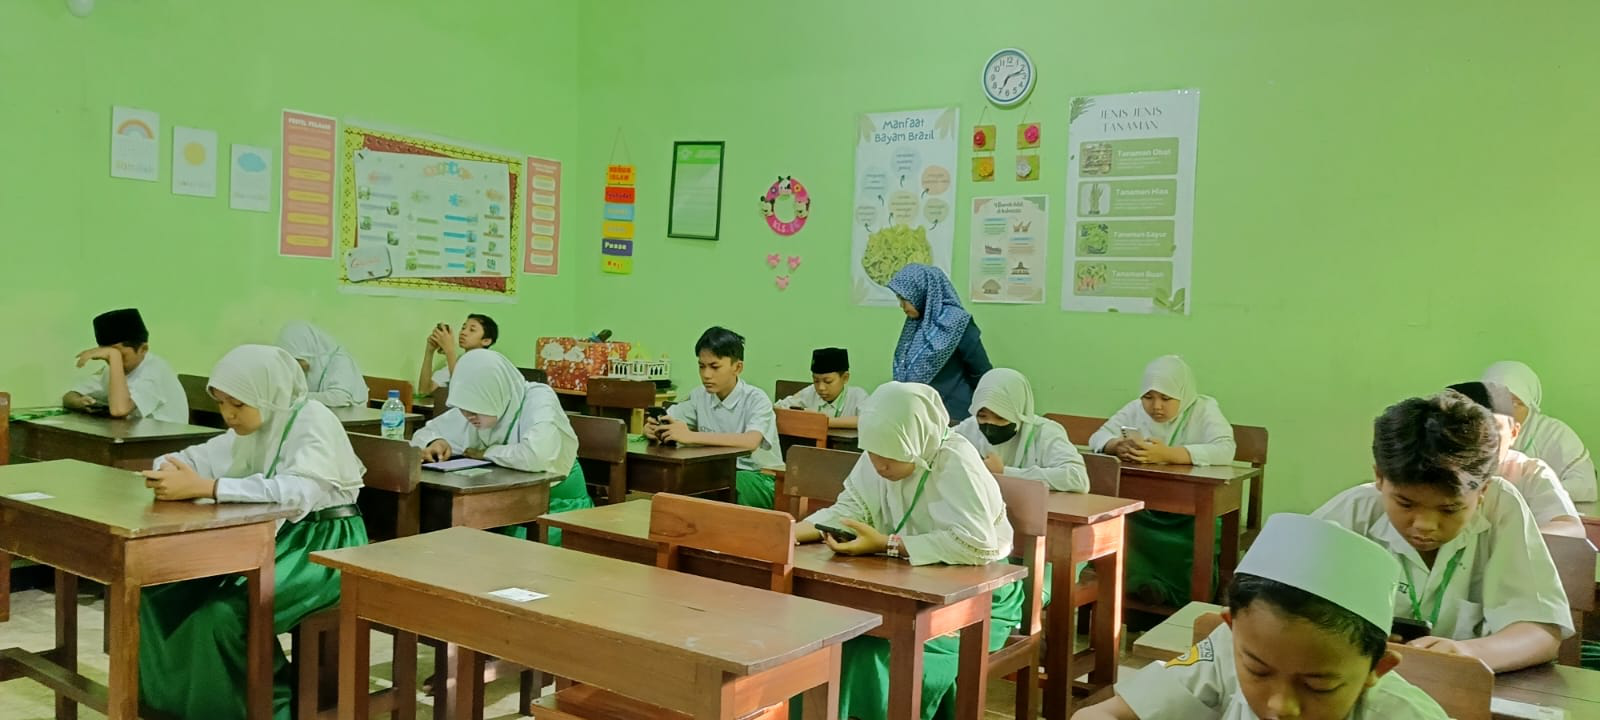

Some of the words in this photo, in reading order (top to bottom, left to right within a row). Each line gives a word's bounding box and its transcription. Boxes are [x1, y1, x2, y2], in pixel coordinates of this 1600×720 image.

[882, 117, 925, 130] Manfaat
[1102, 120, 1158, 133] TANAMAN
[874, 132, 906, 145] Bayam
[908, 129, 934, 141] Brazil
